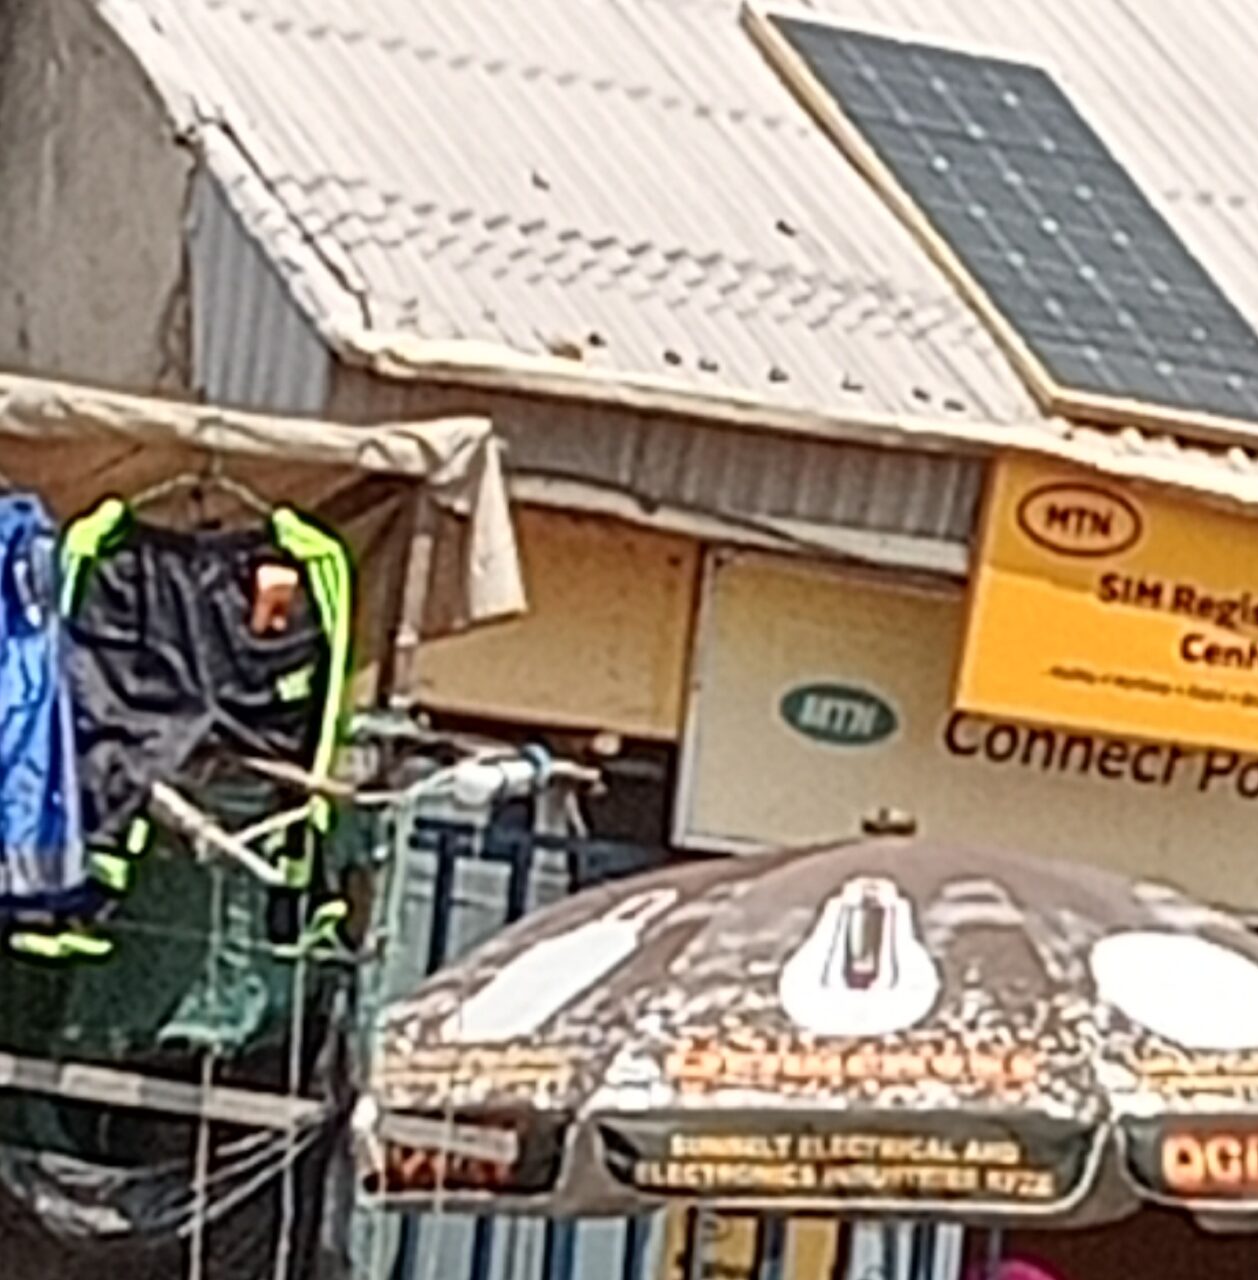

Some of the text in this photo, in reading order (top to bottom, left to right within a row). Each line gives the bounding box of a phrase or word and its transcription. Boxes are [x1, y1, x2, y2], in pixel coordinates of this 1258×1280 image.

[1044, 501, 1113, 538] MTN
[1097, 572, 1164, 609] SIM
[799, 693, 880, 736] MTN
[943, 709, 1183, 786] Connect
